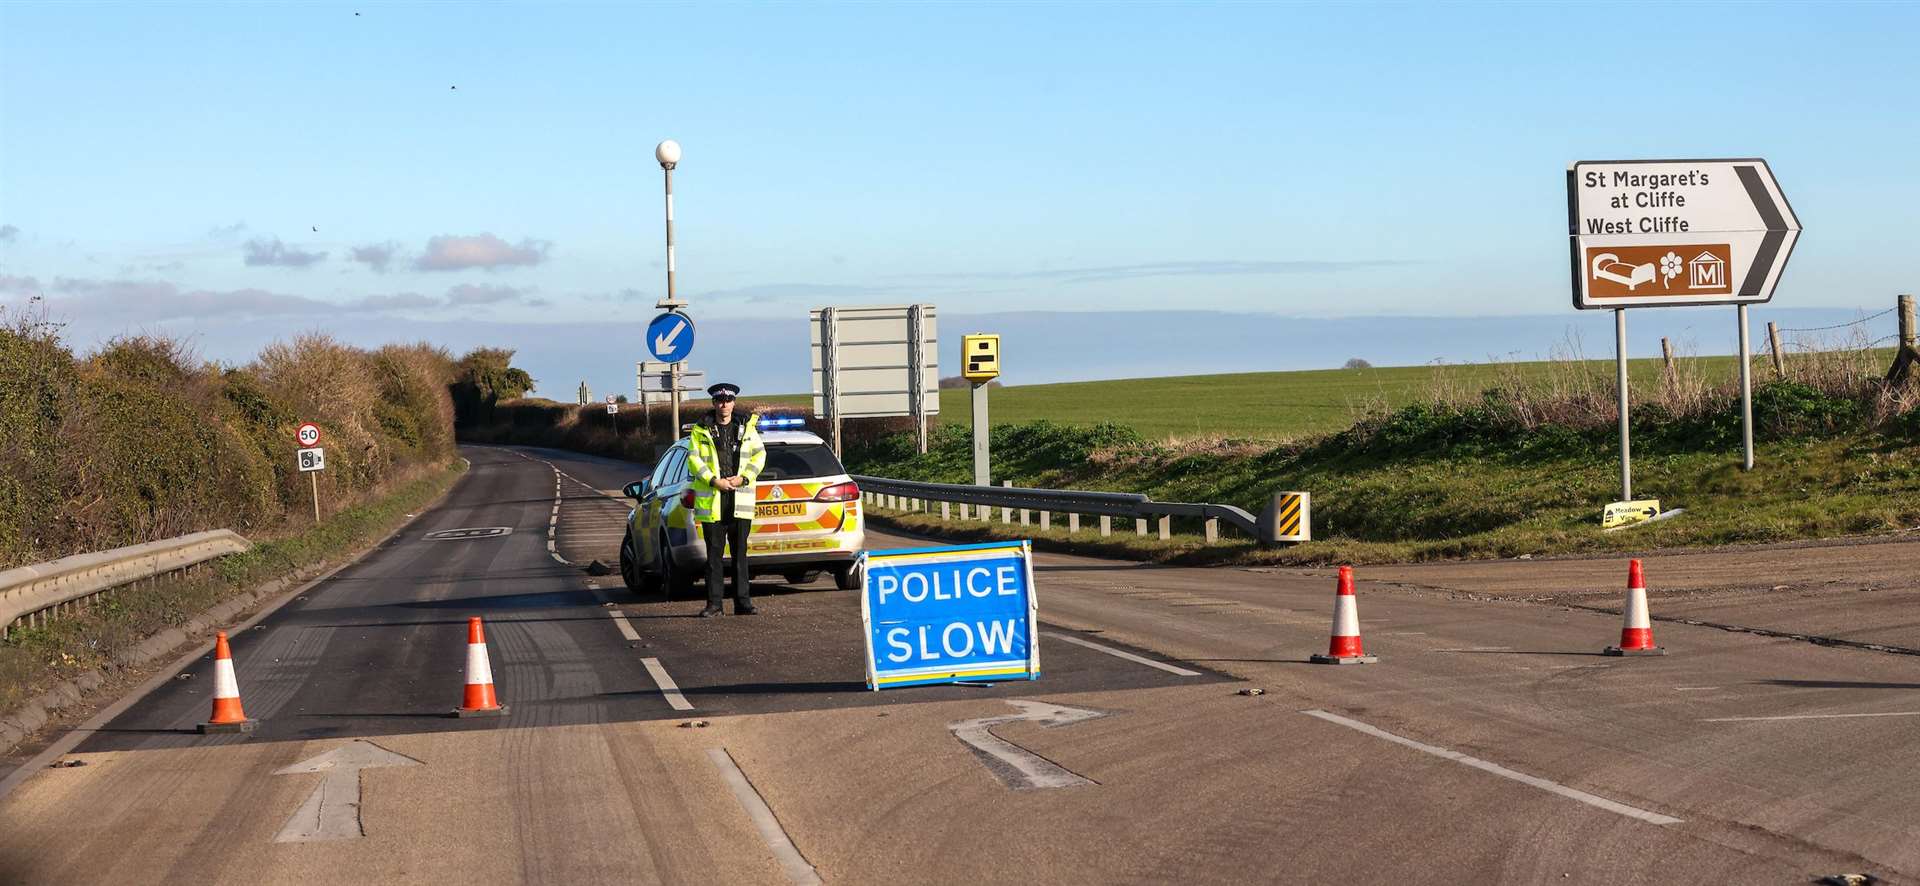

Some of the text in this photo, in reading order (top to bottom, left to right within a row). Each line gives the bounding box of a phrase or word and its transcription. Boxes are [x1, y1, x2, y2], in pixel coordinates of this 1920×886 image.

[1585, 170, 1709, 190] St Margaret's
[1611, 192, 1685, 208] at Cliffe
[1587, 217, 1689, 234] West Cliffe
[1698, 265, 1715, 284] M
[301, 430, 317, 440] 50
[782, 504, 802, 514] CUV
[747, 541, 825, 551] OLICE
[878, 566, 1017, 605] POLICE
[887, 619, 1016, 663] SLOW
